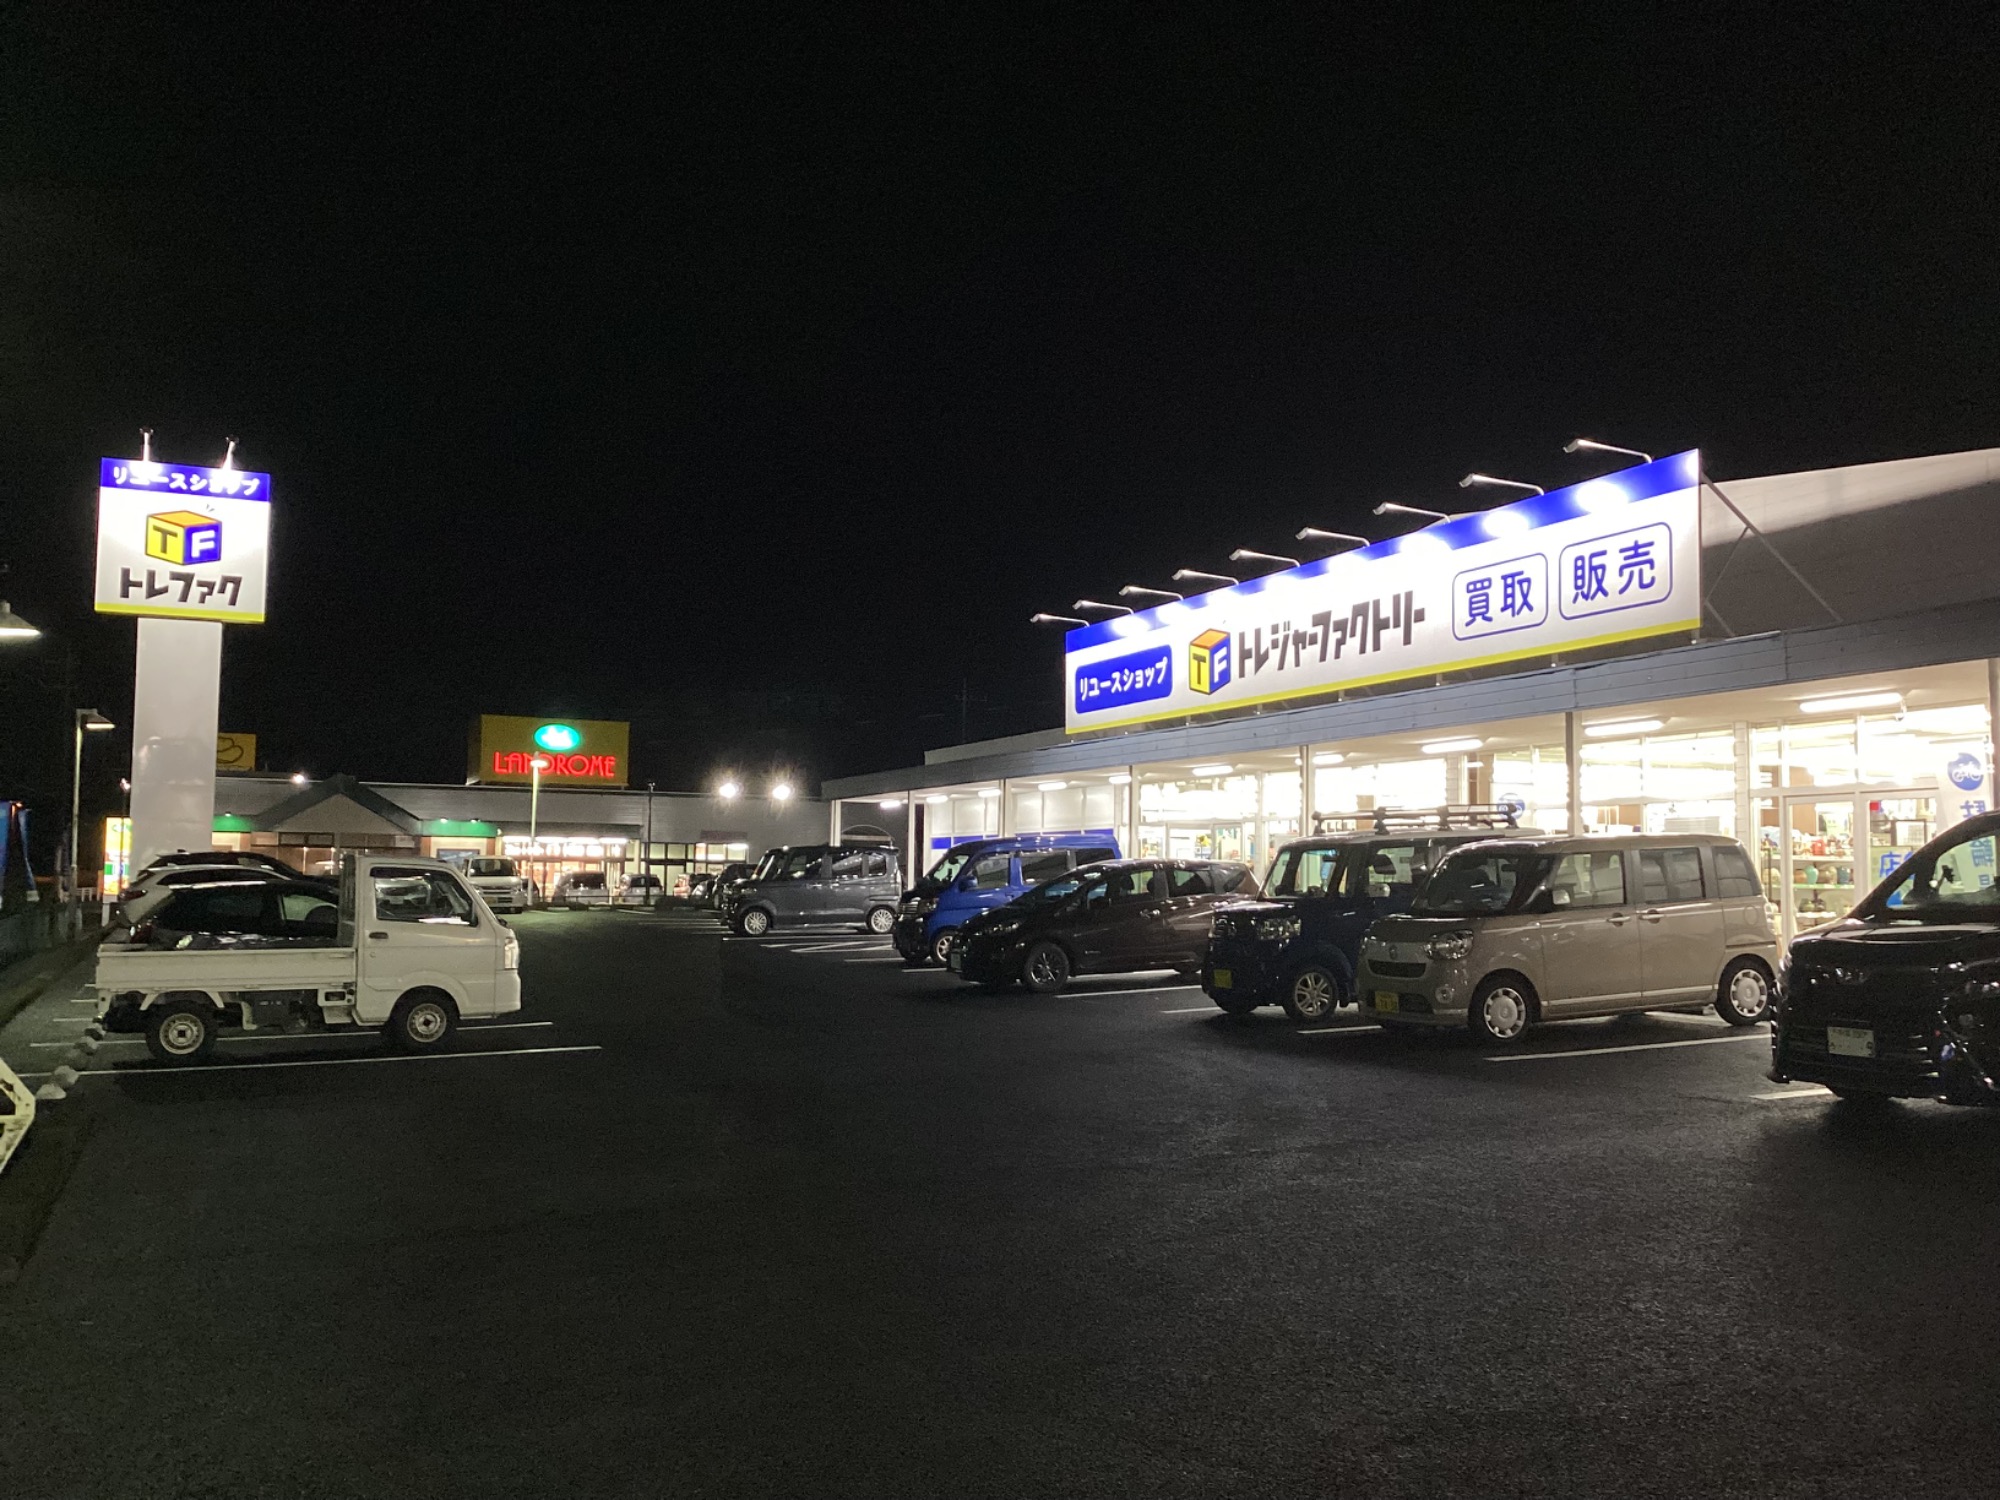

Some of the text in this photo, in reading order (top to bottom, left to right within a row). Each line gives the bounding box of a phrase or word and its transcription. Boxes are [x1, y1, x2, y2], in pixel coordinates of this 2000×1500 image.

[119, 567, 243, 606] トレファク
[1572, 540, 1656, 604] 販売
[1464, 570, 1534, 628] 買取
[1238, 590, 1426, 679] トレジャーファクトリー
[1079, 656, 1169, 702] リユースショップ
[493, 751, 617, 778] LANDROME
